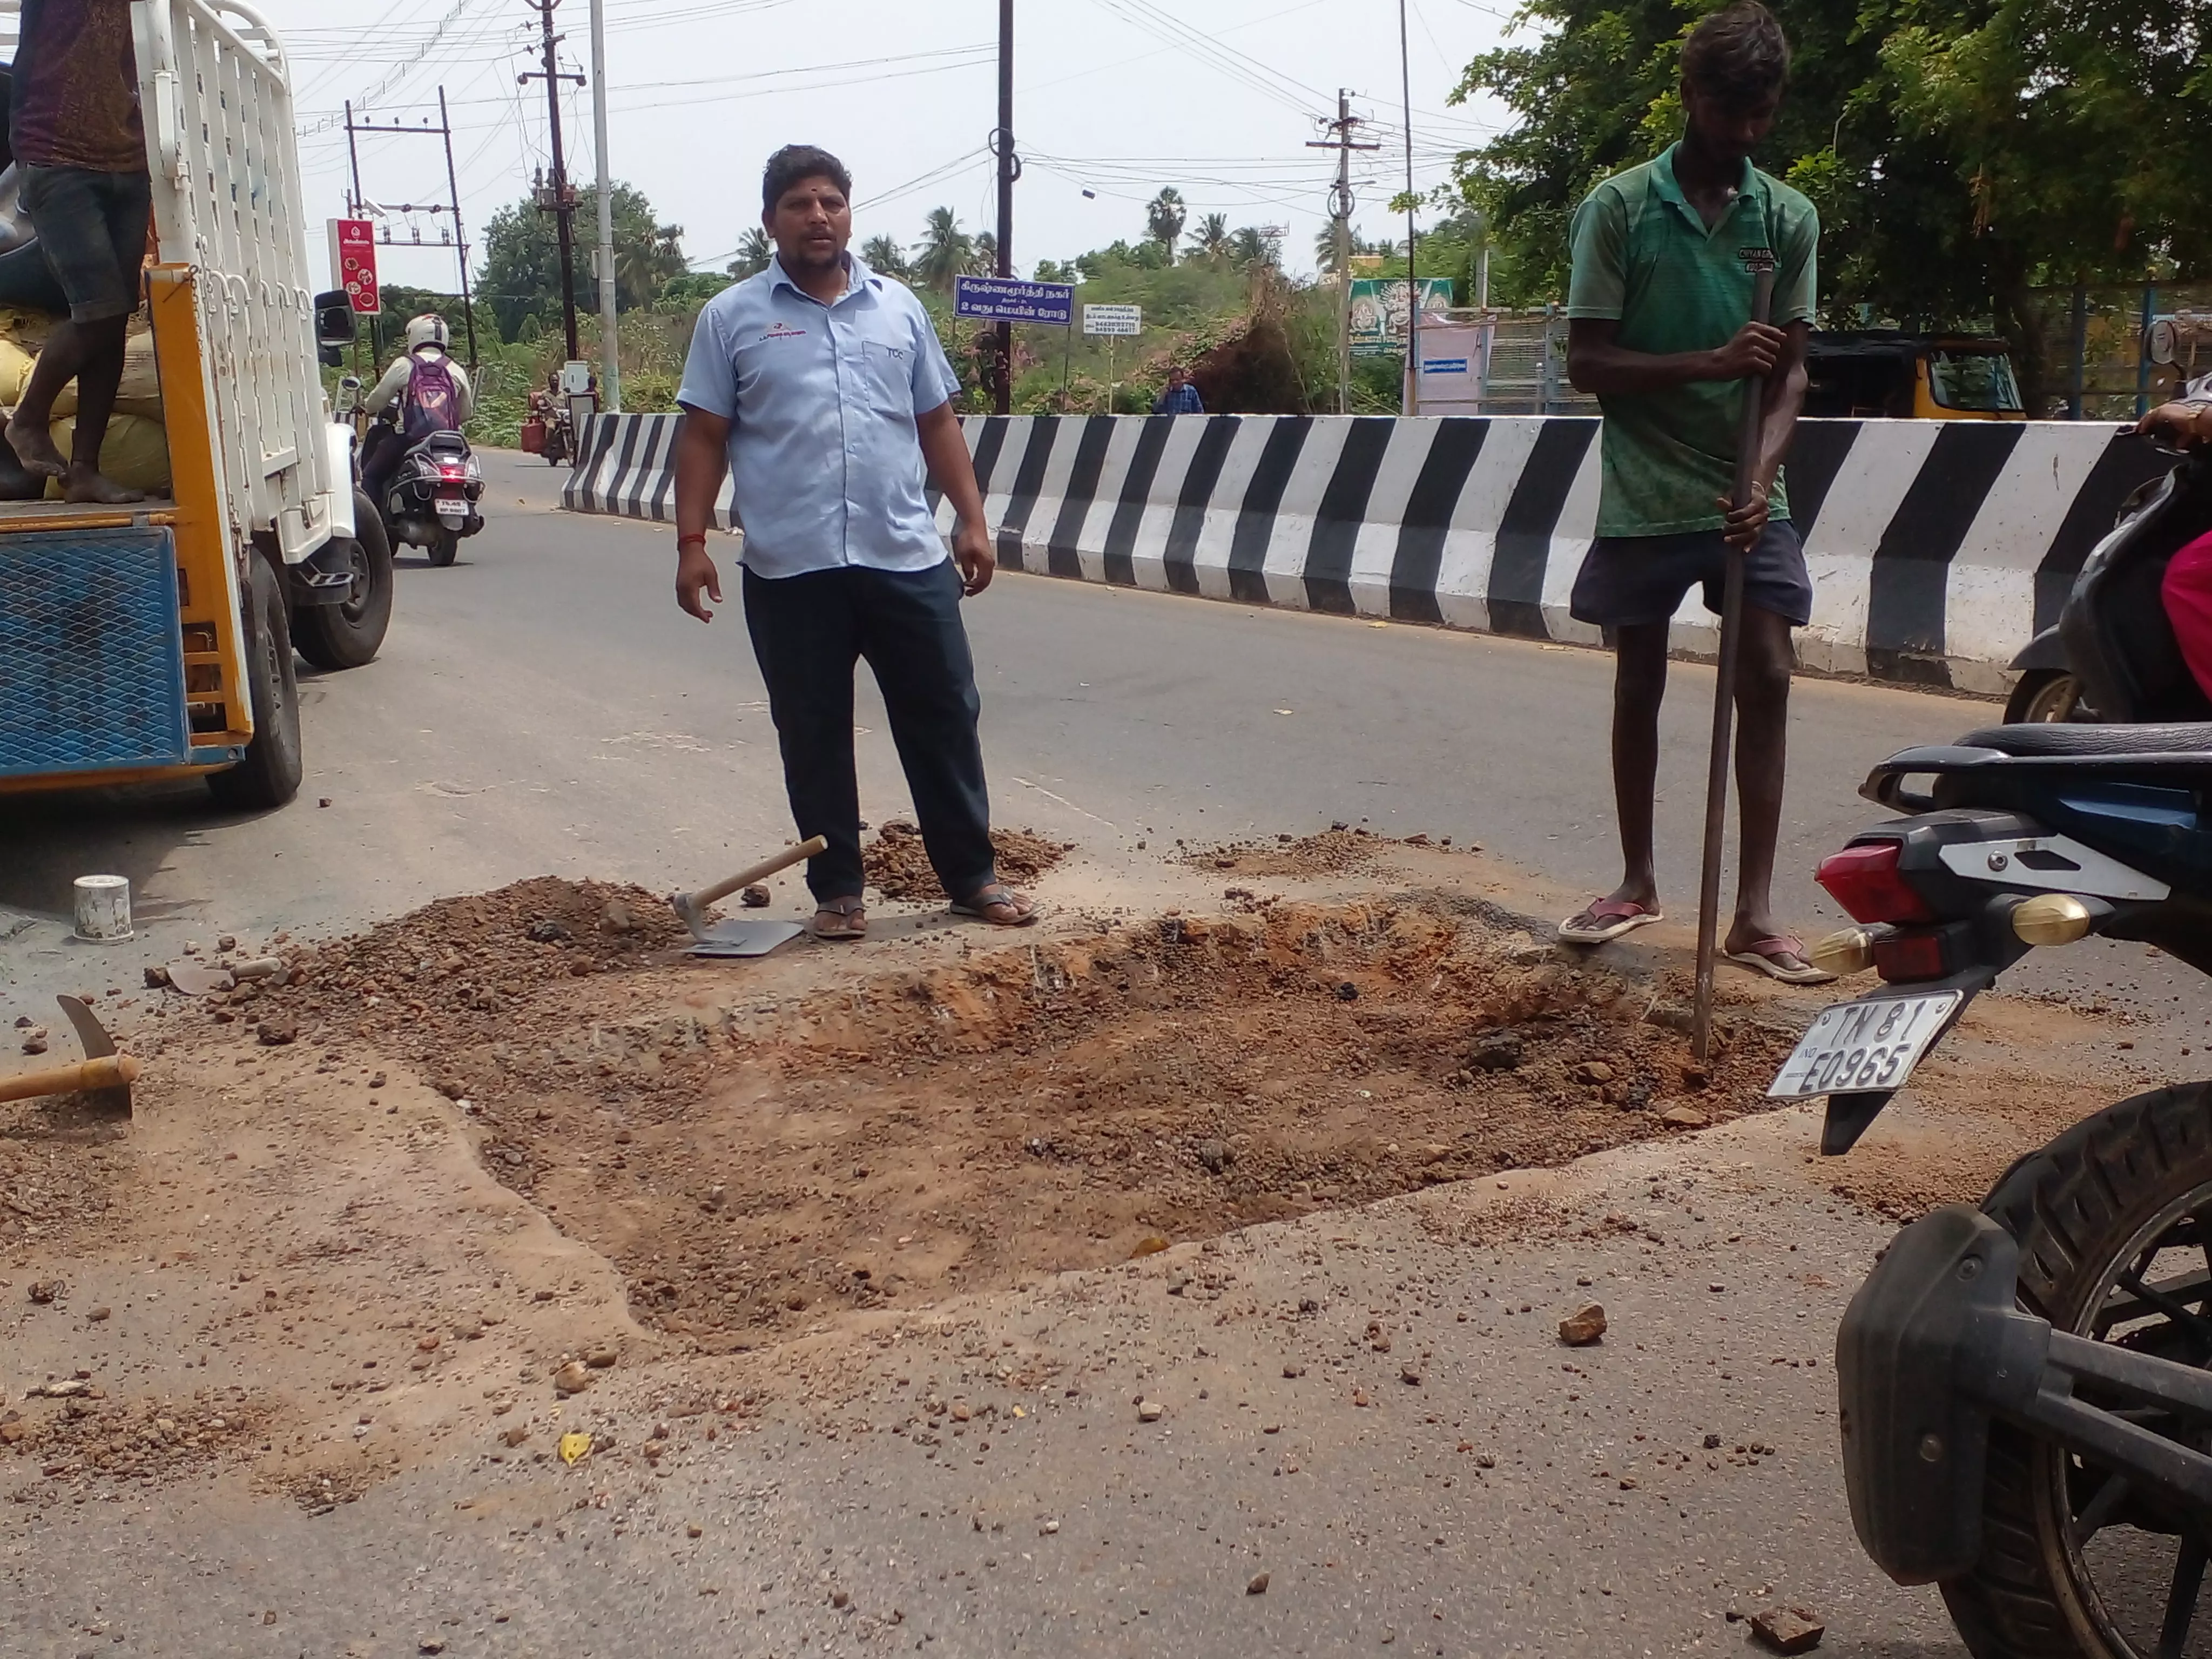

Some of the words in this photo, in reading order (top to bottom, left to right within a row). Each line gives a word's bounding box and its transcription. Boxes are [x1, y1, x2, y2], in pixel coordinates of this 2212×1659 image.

[961, 280, 1044, 298] கிருஷ்ணமூர்த்தி
[1046, 288, 1070, 299] நகர்
[971, 304, 993, 314] வது
[995, 305, 1035, 316] மெயின்
[1037, 308, 1067, 320] ரோடு
[1830, 1004, 1879, 1048] TN
[1873, 999, 1927, 1044] 81
[1798, 1042, 1912, 1094] E0965
